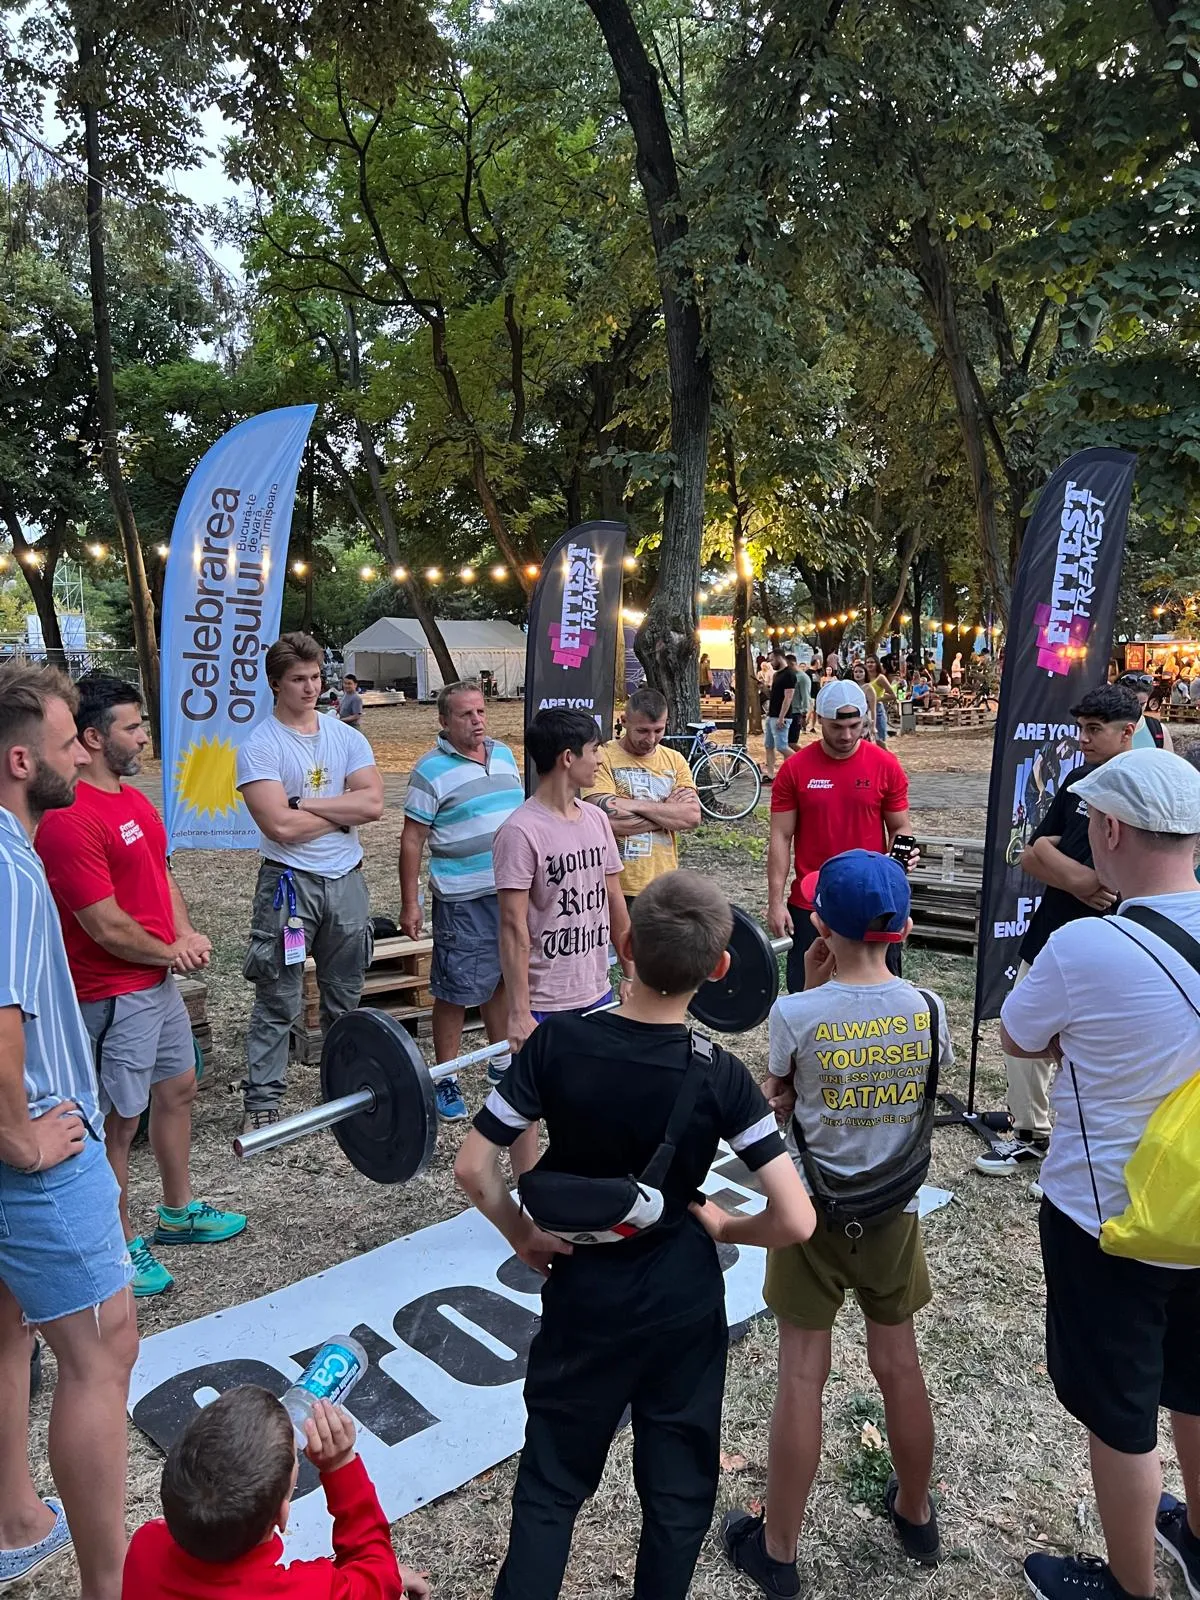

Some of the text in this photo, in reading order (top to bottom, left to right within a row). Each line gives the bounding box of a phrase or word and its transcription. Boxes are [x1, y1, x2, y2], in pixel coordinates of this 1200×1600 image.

[236, 494, 257, 551] Bucură-te
[247, 537, 258, 552] de
[1073, 490, 1106, 618] FREAKEST
[1047, 480, 1089, 646] FITTEST
[181, 487, 241, 721] Celebrarea
[560, 543, 588, 649] FITTEST
[580, 548, 603, 631] FREAKEST
[566, 698, 594, 711] YOU
[1013, 722, 1081, 741] ARE YOU
[171, 828, 257, 838] celebrare-timisoara.ro
[556, 880, 606, 919] Rich
[815, 1015, 908, 1042] ALWAYS
[819, 1072, 868, 1085] UNLESS
[871, 1069, 895, 1082] YOU
[897, 1065, 922, 1079] CAN
[883, 1114, 895, 1124] BE
[311, 1354, 349, 1387] Ca
